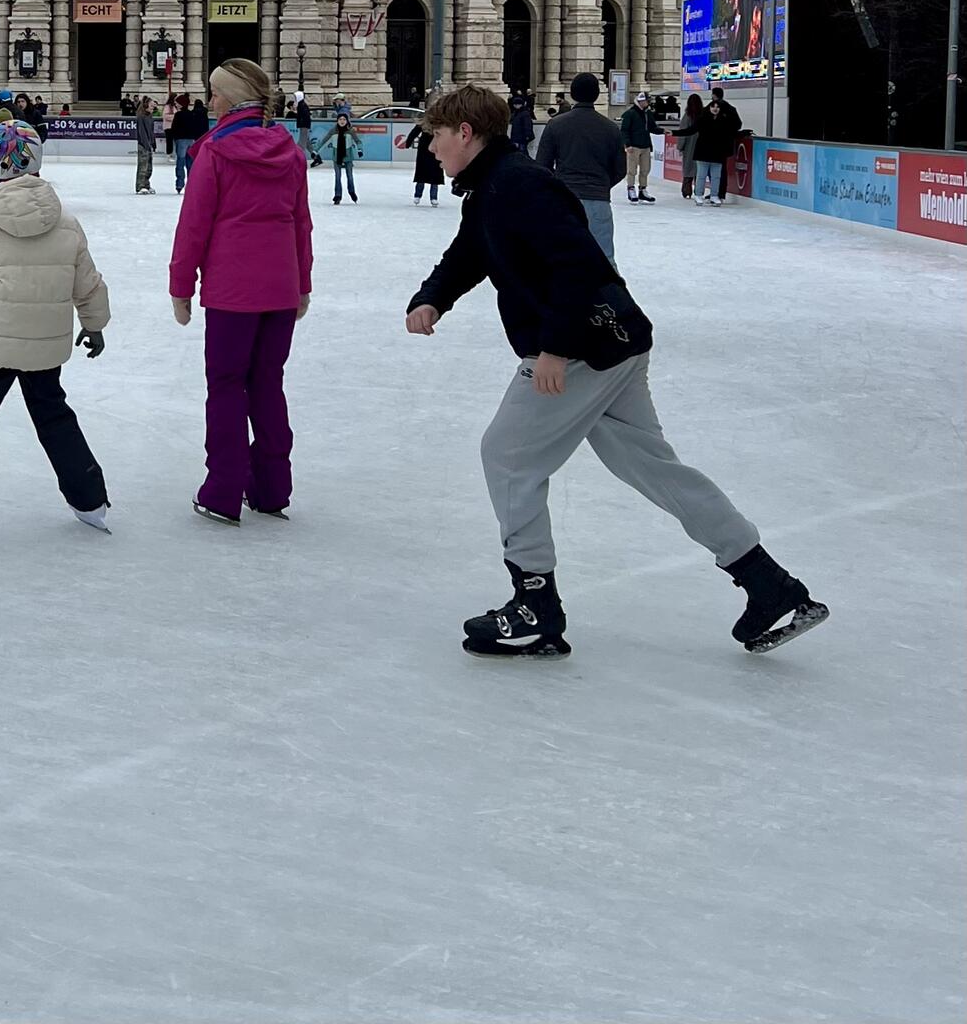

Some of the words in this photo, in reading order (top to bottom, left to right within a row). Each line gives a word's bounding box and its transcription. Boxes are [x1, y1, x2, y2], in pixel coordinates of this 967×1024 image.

[82, 5, 112, 15] ECHT
[217, 5, 247, 15] JETZT
[51, 120, 67, 129] -50
[78, 120, 93, 129] auf
[95, 120, 115, 129] dein
[117, 120, 137, 129] Tick
